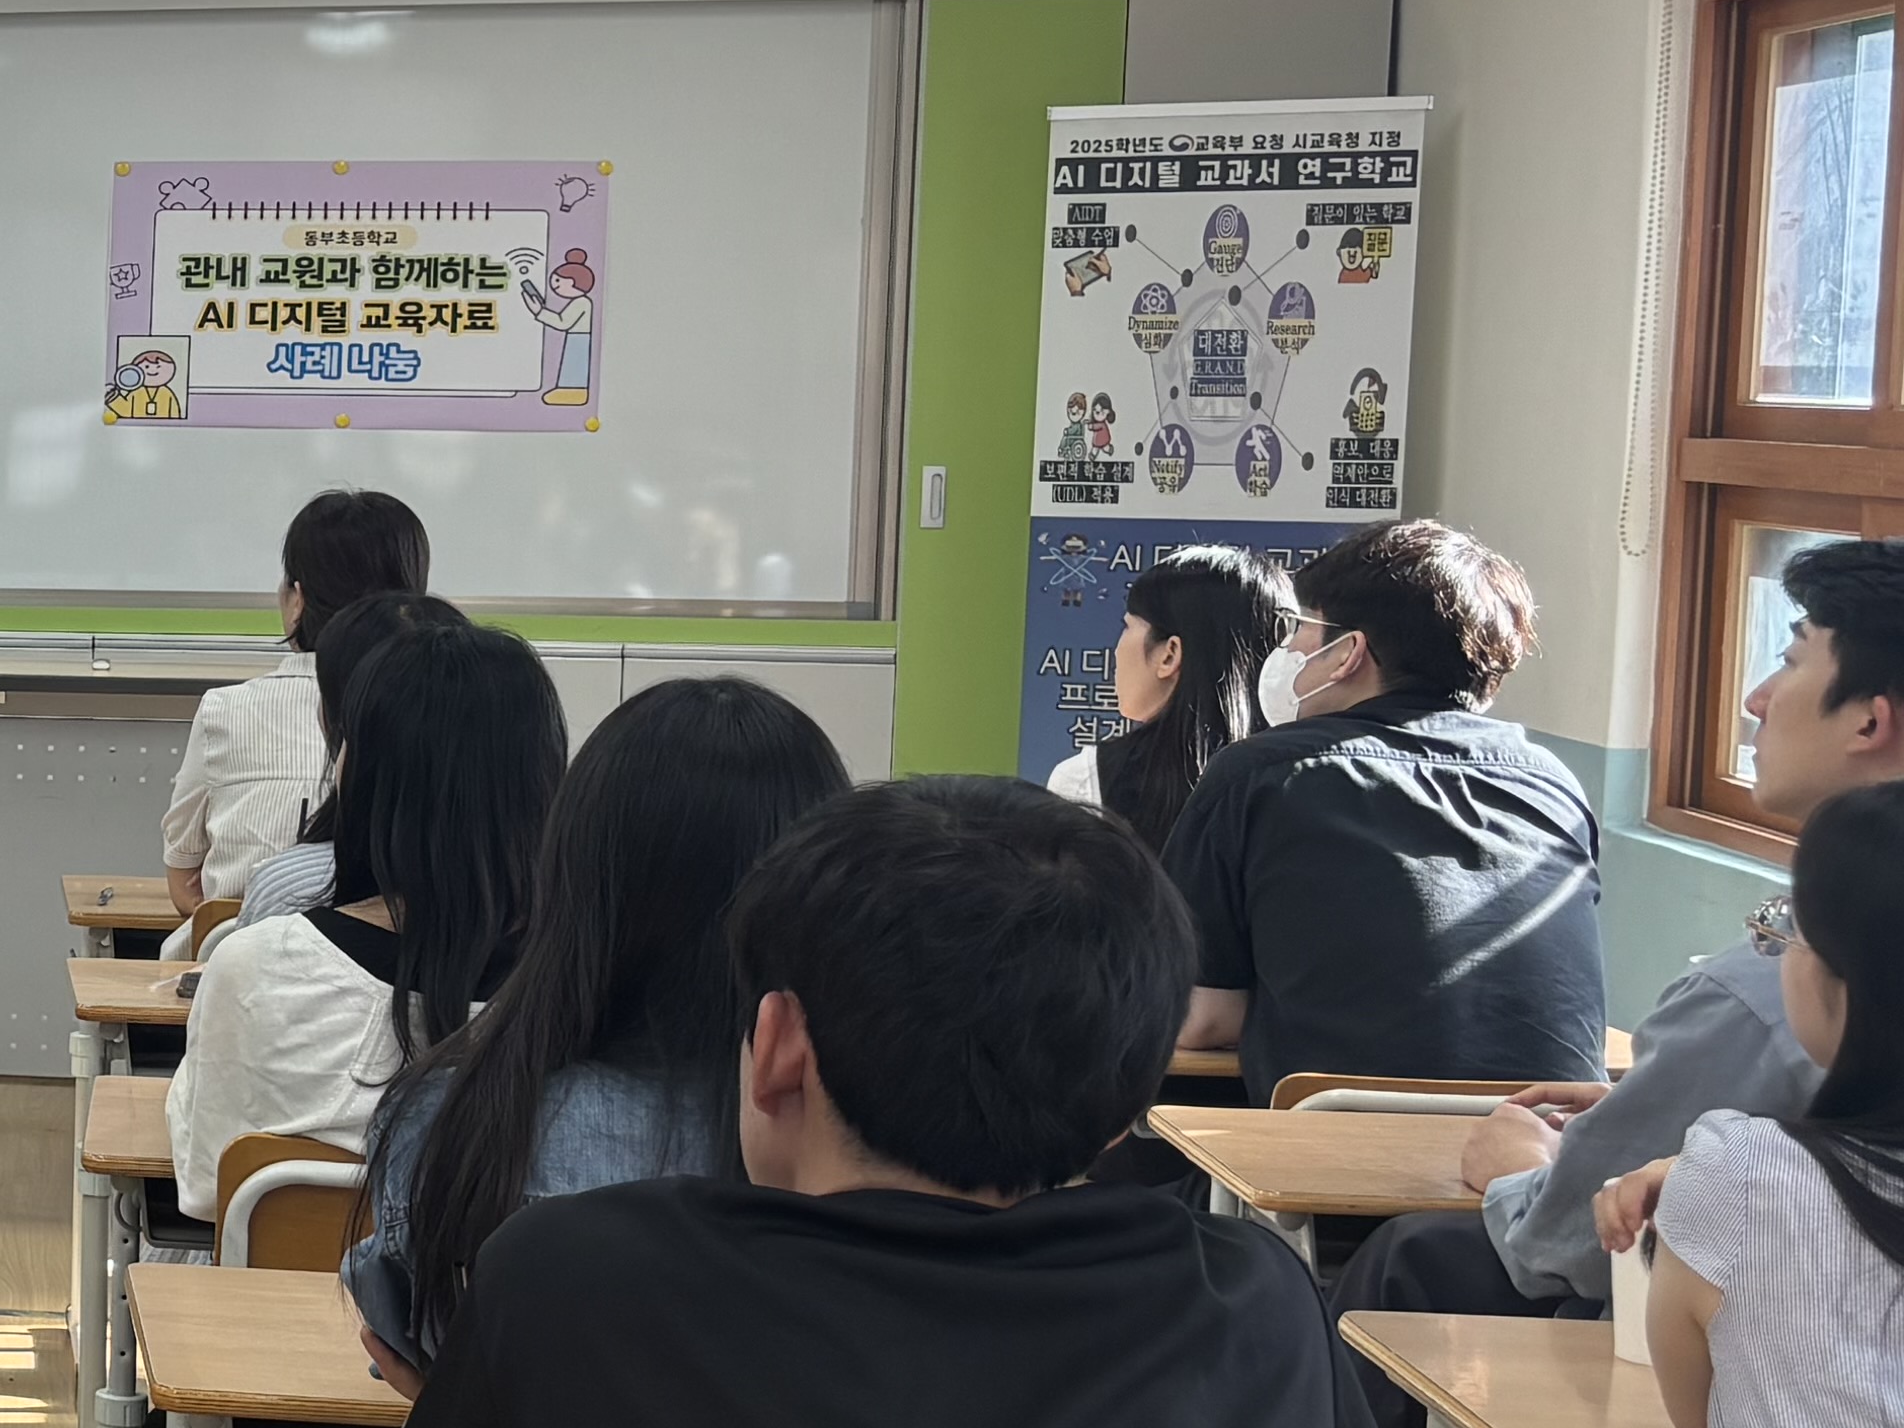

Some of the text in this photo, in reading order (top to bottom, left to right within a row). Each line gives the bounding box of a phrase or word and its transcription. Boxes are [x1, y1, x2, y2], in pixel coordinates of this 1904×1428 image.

[1070, 131, 1402, 154] 2025학년도 교육부 요청 시교육청 지정
[1055, 155, 1414, 188] AI 디지털 교과서 연구학교
[304, 230, 397, 246] 동부초등학교
[1208, 240, 1241, 258] Gauge
[179, 254, 507, 290] 관내 교원과 함께하는
[198, 301, 496, 334] AI 디지털 교육자료
[1128, 316, 1179, 333] Dynamize
[1266, 321, 1315, 336] Research
[267, 342, 420, 382] 사례 나눔
[1110, 545, 1141, 571] AI
[1040, 649, 1110, 680] AI 디
[1058, 684, 1119, 710] 프로
